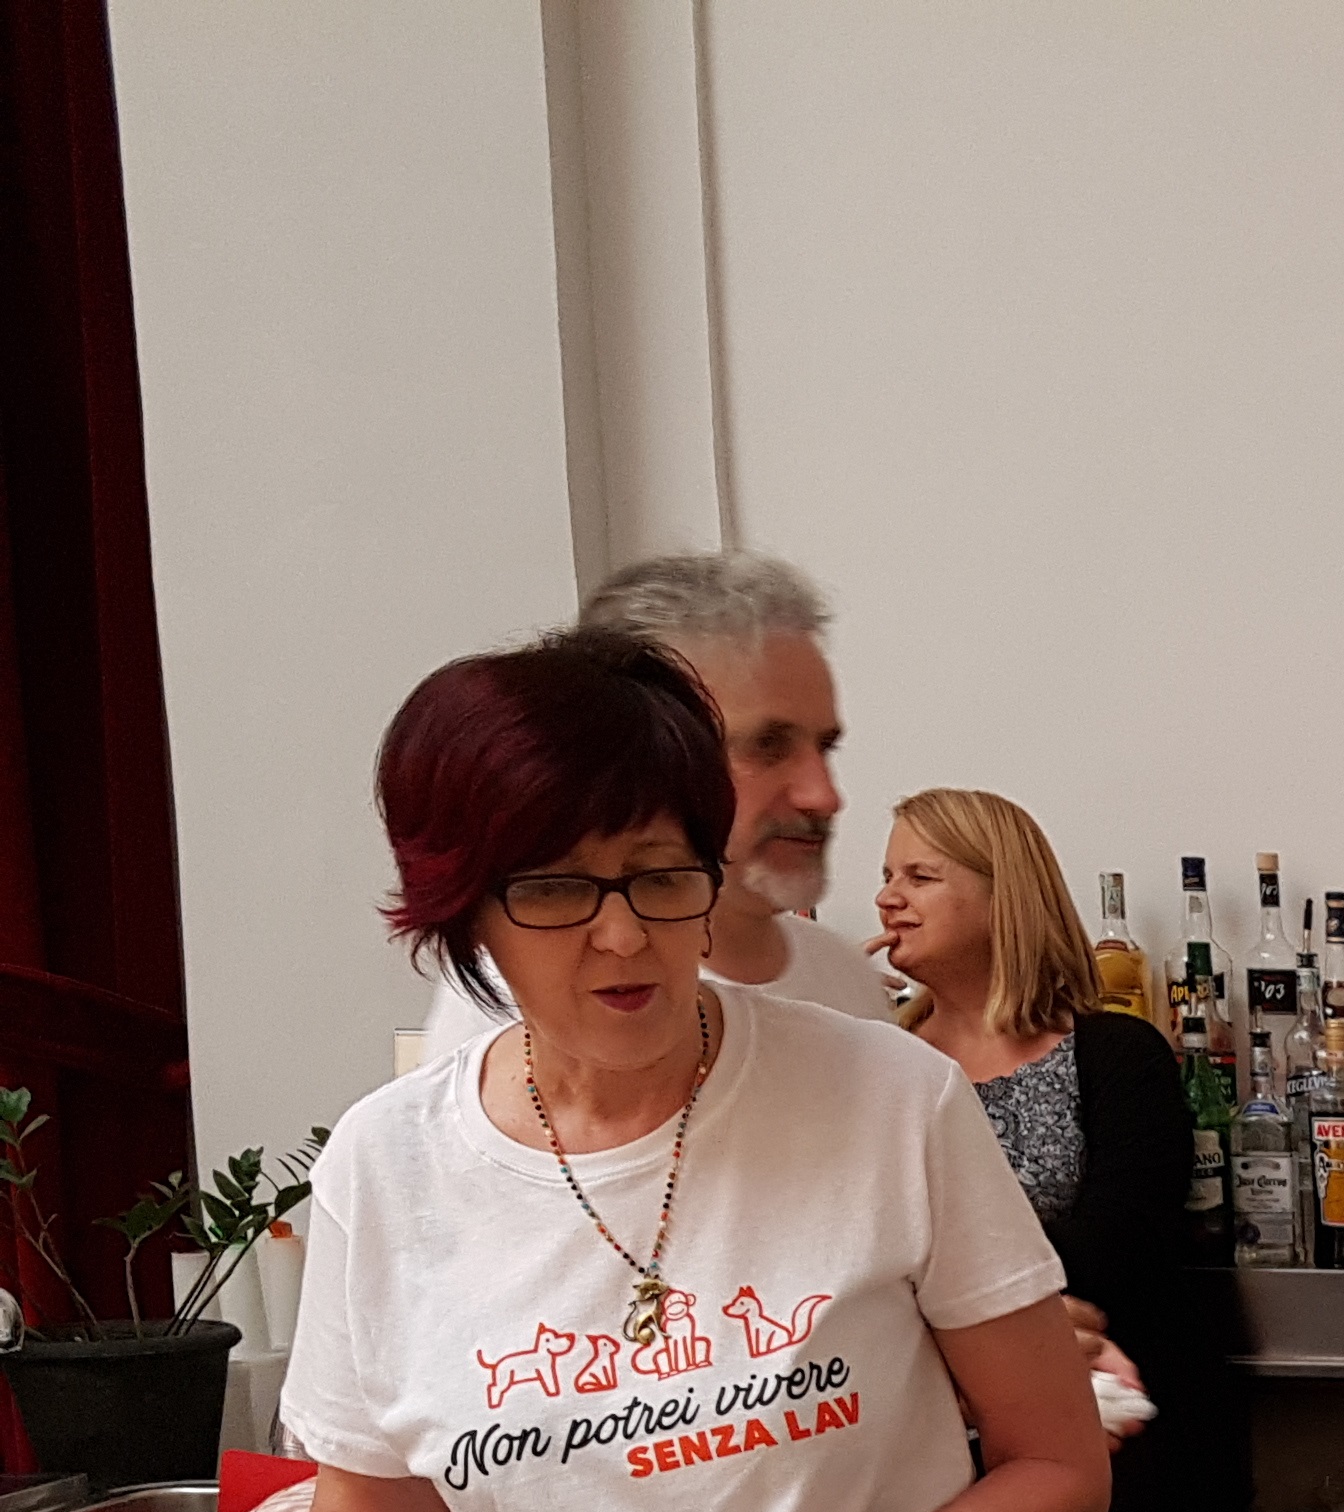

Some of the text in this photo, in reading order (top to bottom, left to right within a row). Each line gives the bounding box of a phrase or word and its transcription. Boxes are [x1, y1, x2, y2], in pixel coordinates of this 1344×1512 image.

[444, 1355, 852, 1491] Non potrei vivere
[626, 1391, 862, 1479] SENZA LAV
